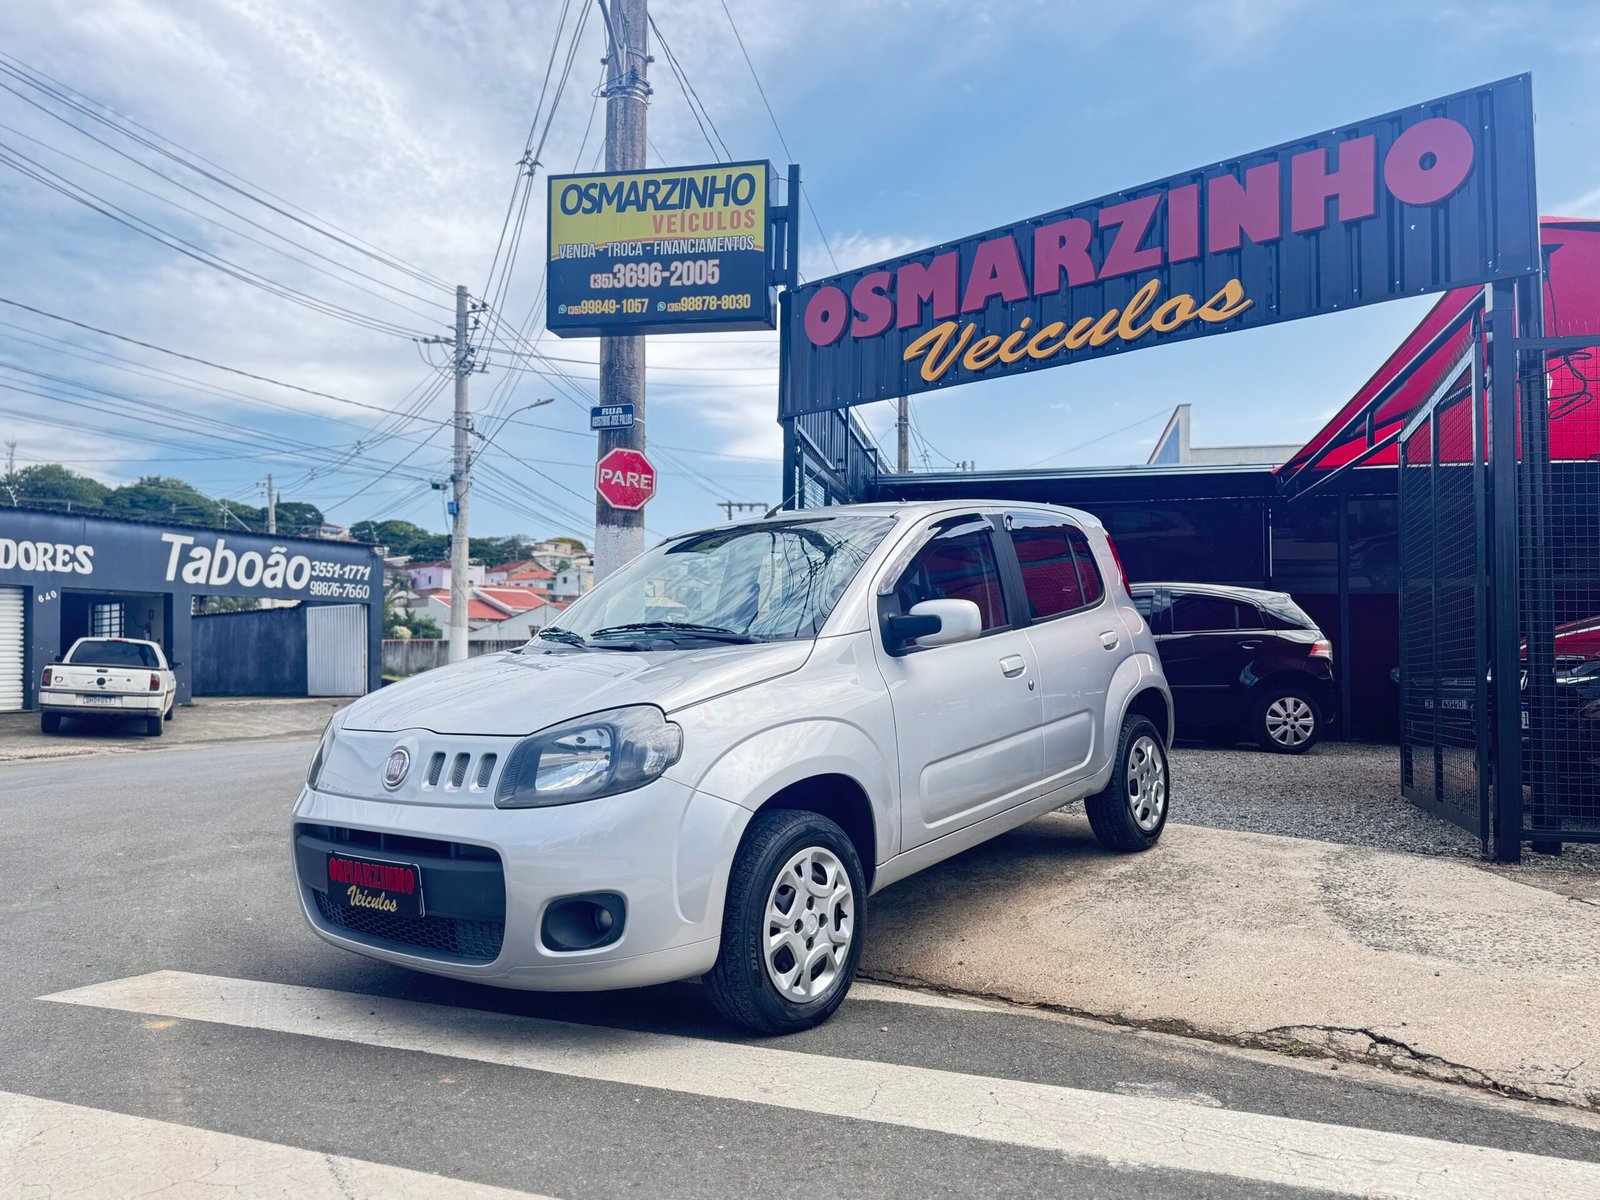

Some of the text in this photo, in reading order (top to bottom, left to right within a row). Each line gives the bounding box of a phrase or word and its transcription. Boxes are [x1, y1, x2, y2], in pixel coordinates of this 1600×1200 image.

[560, 173, 756, 216] OSMARZINHO
[652, 209, 756, 234] VEÍCULOS
[803, 118, 1475, 347] OSMARZINHO
[558, 243, 596, 259] VENDA
[606, 241, 643, 257] TROCA
[653, 235, 755, 255] FINANCIAMENTOS
[903, 278, 1254, 382] Veiculos
[601, 407, 623, 415] RUA
[599, 468, 652, 490] PARE
[0, 538, 94, 575] DORES
[161, 532, 311, 590] Taboão
[329, 857, 415, 896] OSMARZINHO
